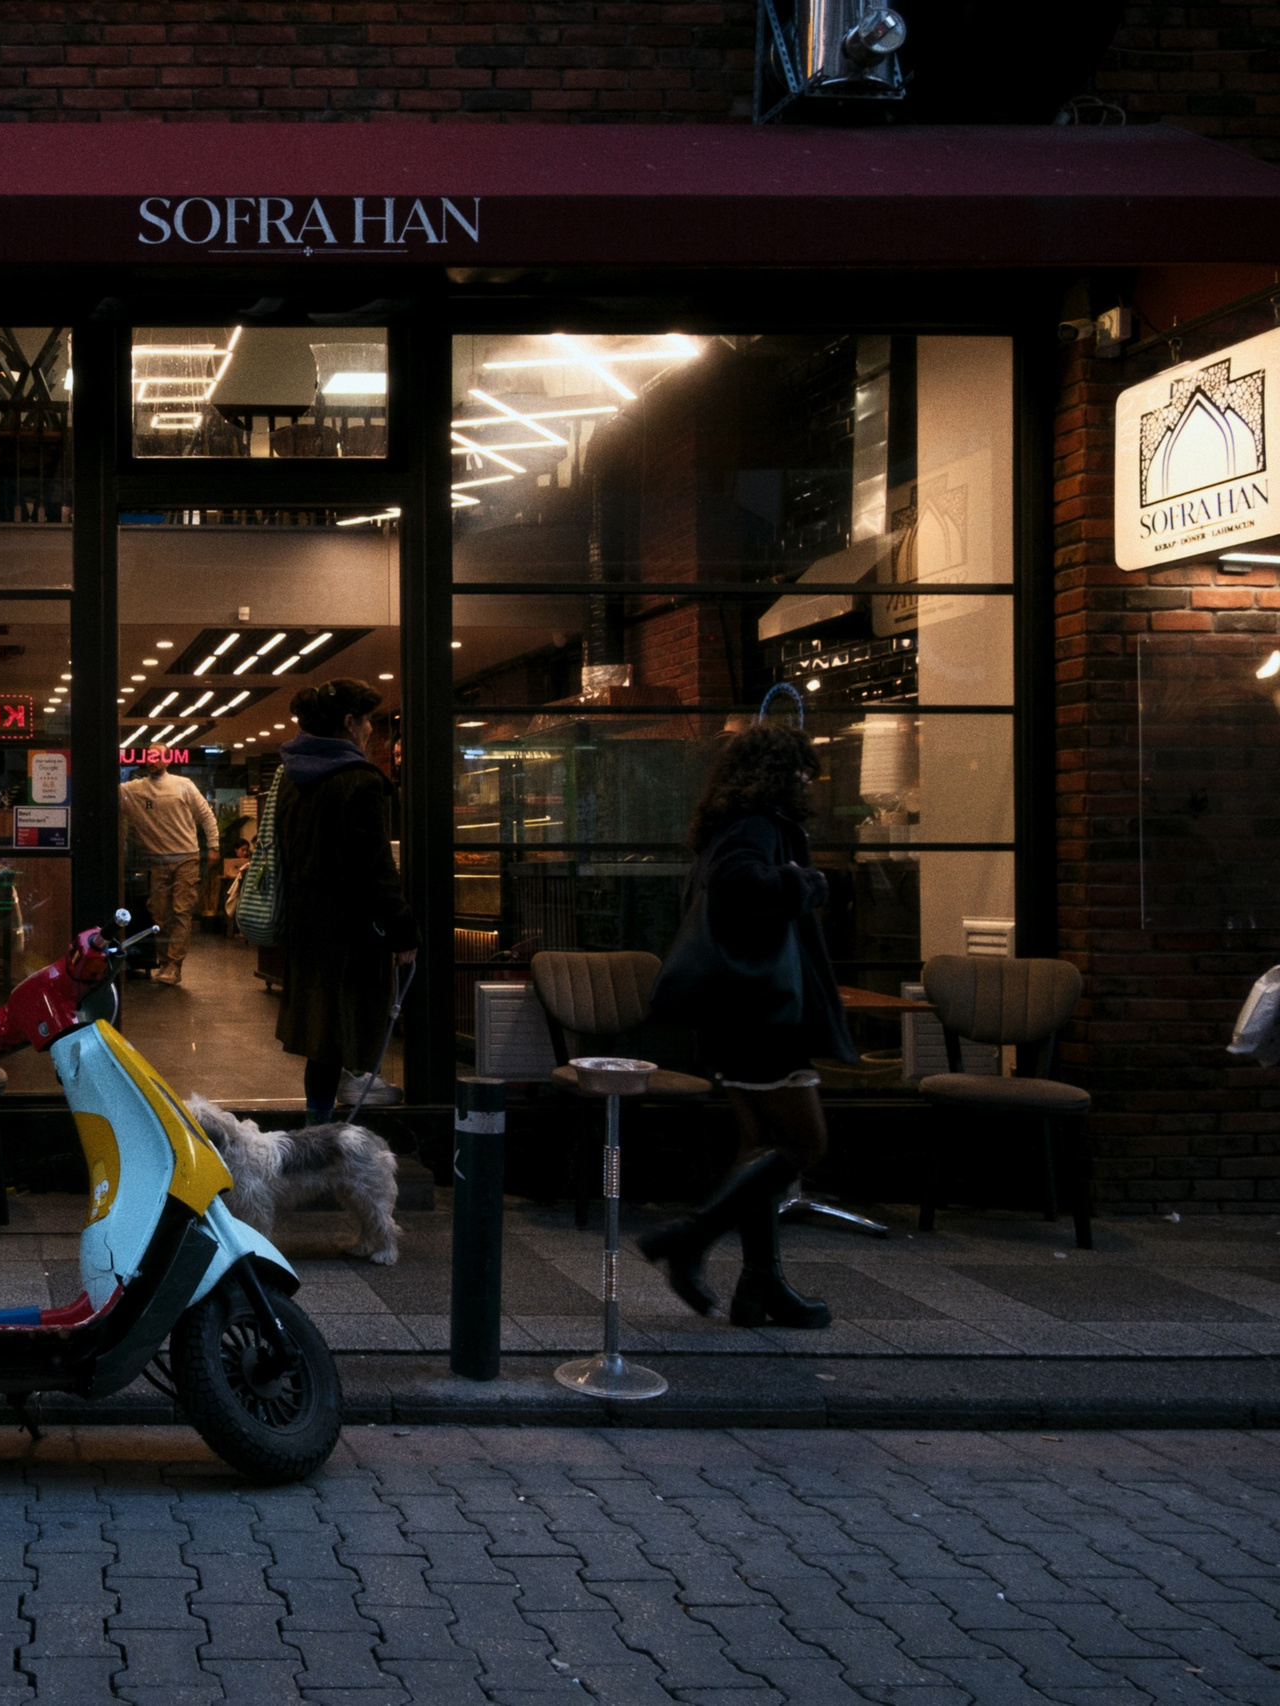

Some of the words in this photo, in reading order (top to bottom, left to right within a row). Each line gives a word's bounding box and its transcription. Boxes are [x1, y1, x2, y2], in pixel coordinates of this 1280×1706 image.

[137, 196, 338, 244] SOFRA
[353, 196, 481, 244] HAN
[1140, 498, 1212, 540] SOFRA
[1216, 479, 1269, 517] HAN
[1180, 532, 1206, 546] DÖNER
[1211, 519, 1255, 537] LAHMACUN
